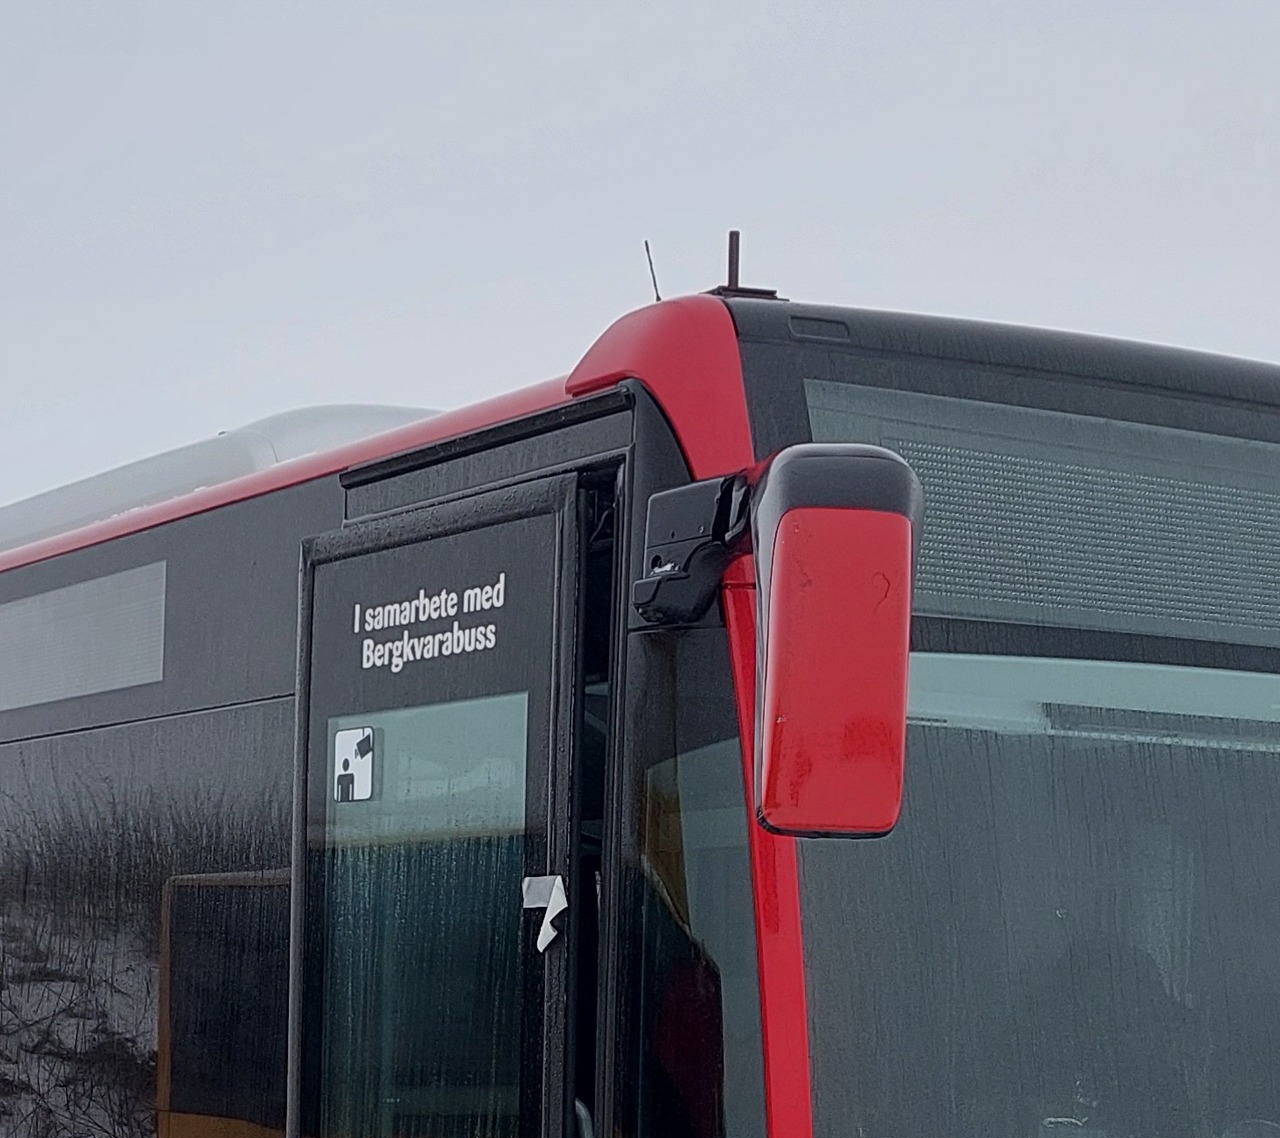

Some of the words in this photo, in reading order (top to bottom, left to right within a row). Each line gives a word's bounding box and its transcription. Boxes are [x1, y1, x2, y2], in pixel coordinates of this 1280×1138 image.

[354, 603, 362, 633] I
[364, 588, 458, 631] samarbete
[462, 573, 506, 613] med
[362, 621, 496, 673] Bergkvarabuss
